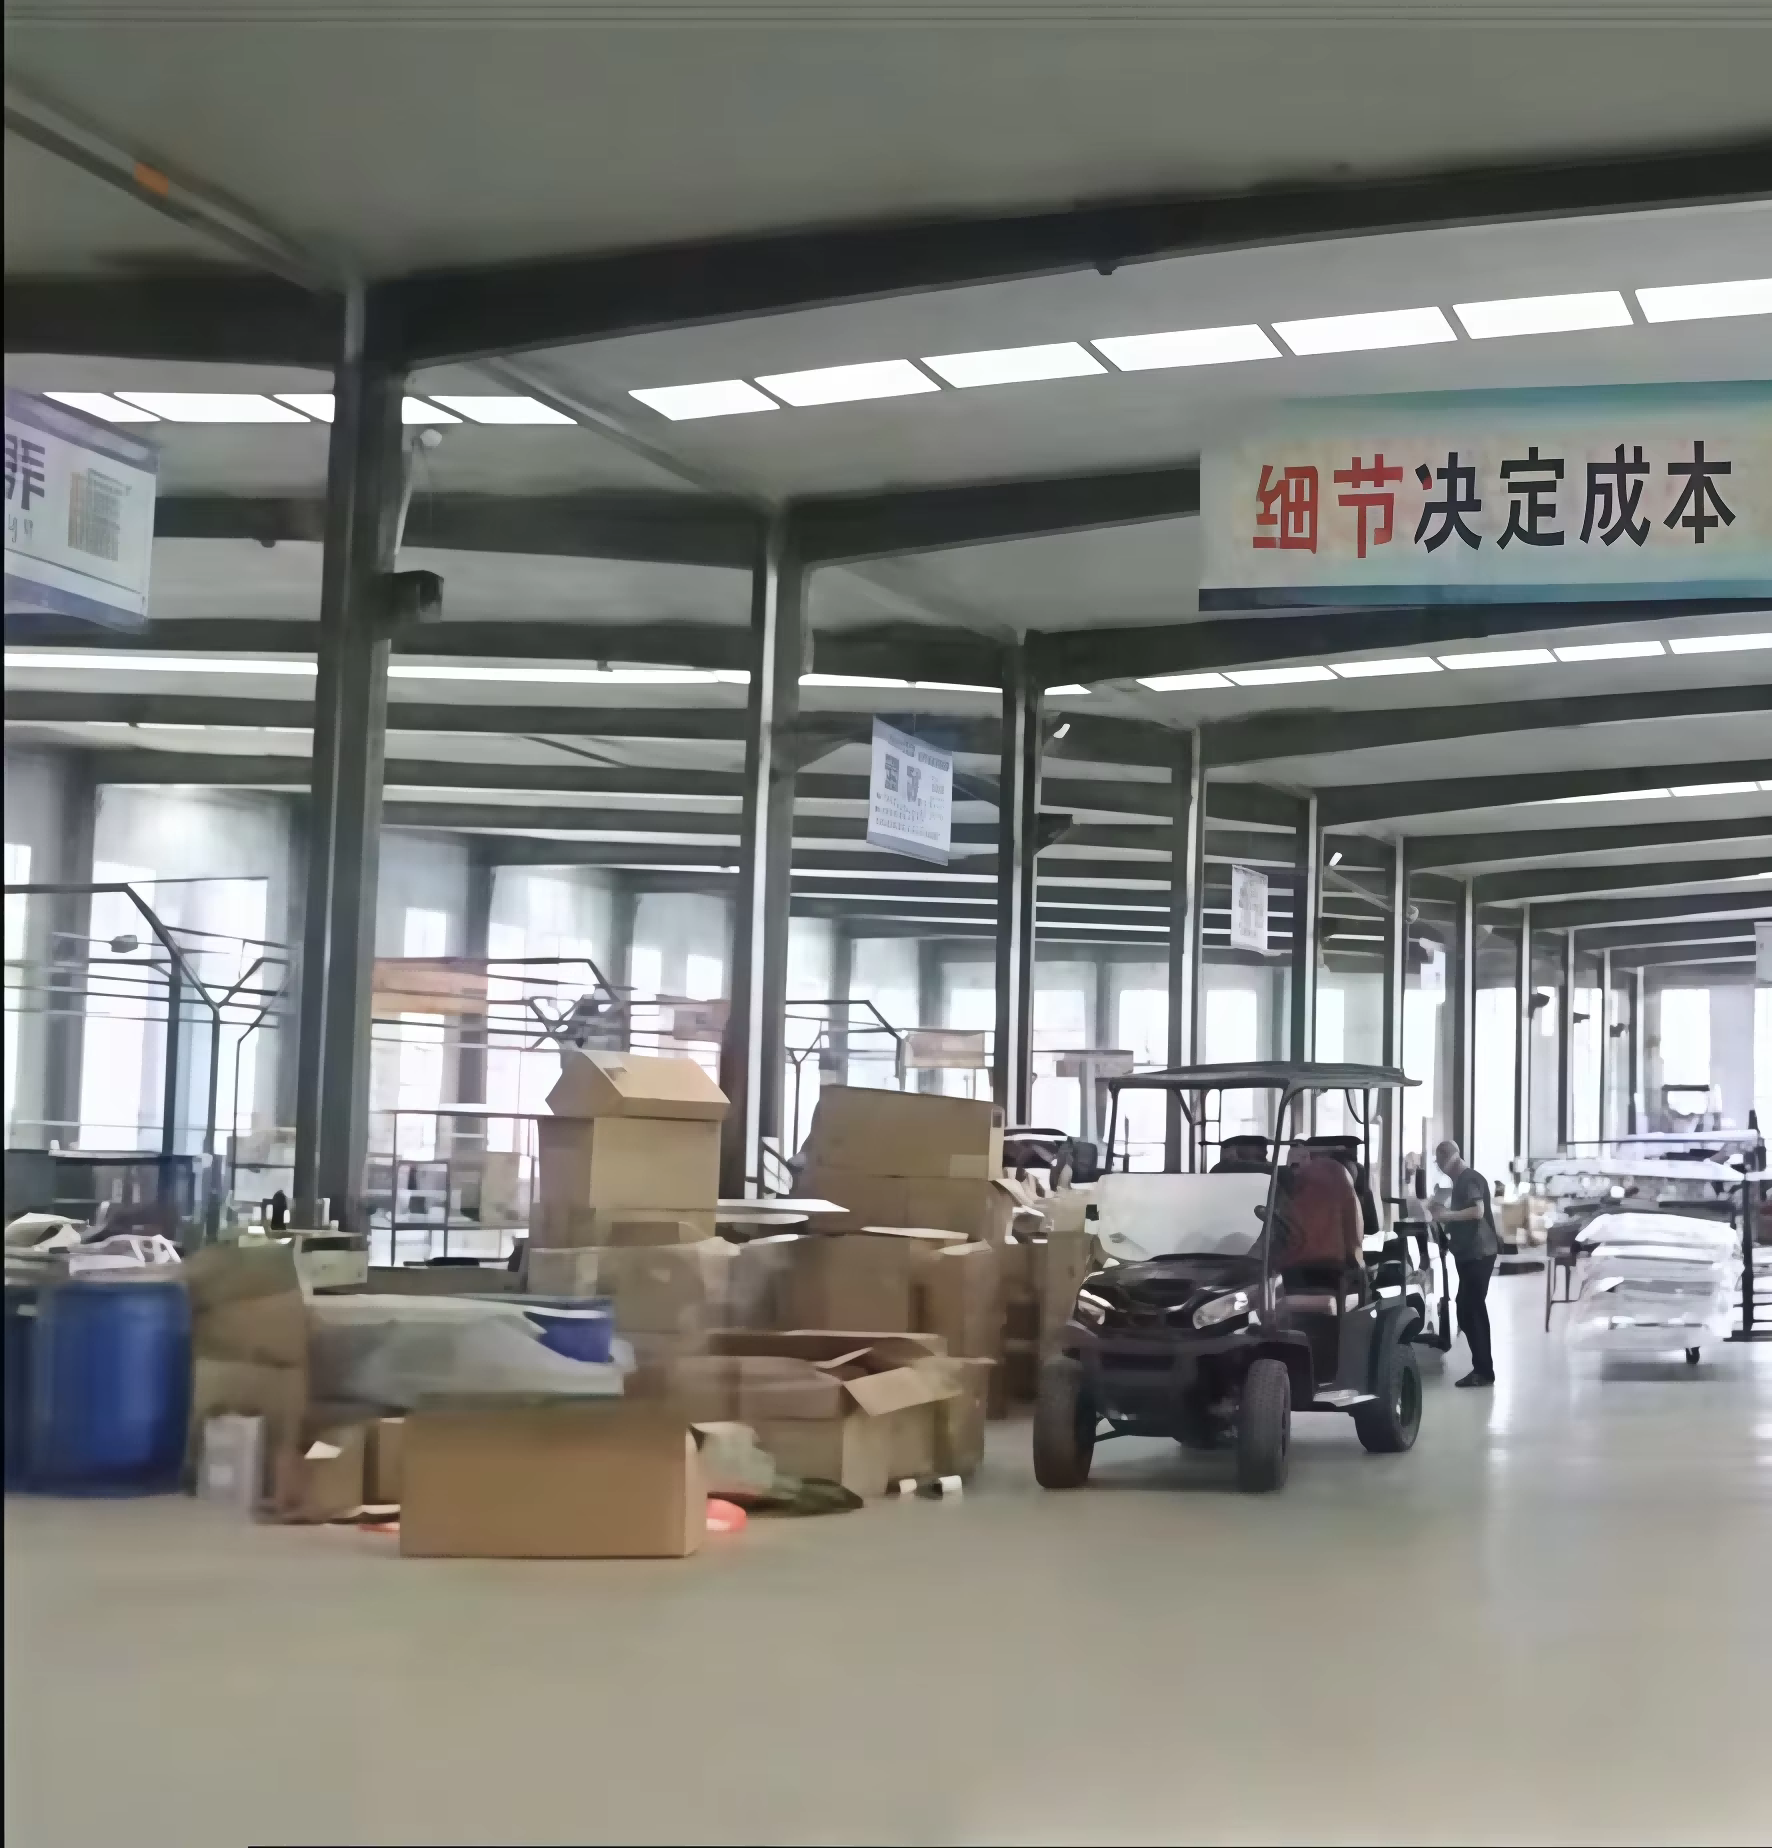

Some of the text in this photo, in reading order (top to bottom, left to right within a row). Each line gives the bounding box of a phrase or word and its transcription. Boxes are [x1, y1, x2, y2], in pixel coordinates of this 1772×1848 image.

[1252, 440, 1737, 559] 细节决定成本
